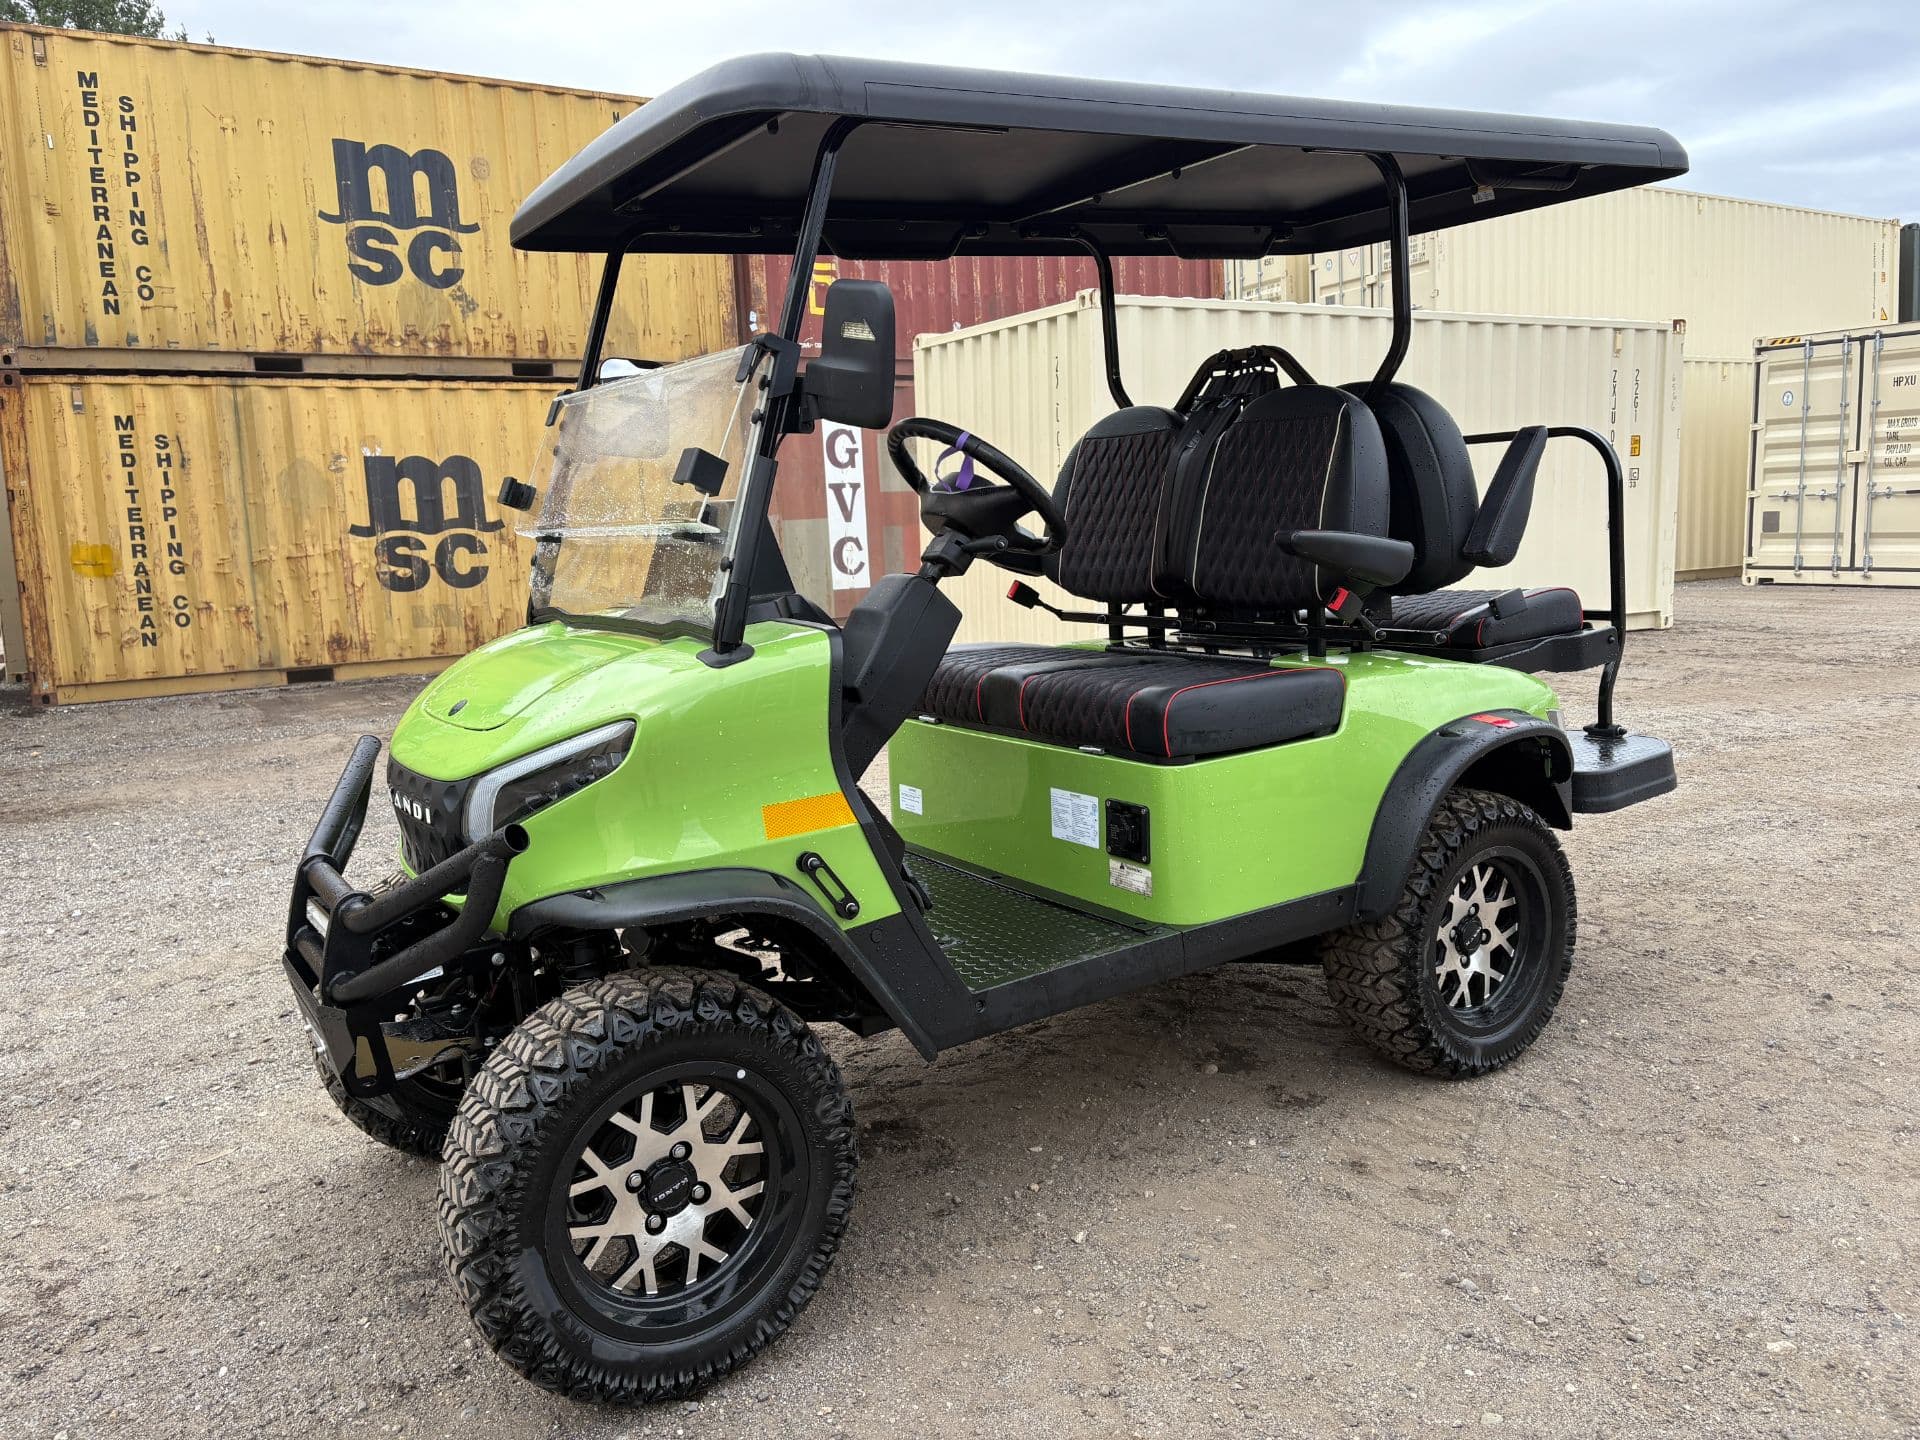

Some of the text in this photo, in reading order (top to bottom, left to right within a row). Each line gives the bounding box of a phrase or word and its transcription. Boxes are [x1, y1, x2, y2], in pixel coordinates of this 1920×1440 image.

[77, 71, 121, 315] MEDITERRANEAN
[118, 95, 155, 301] SHIPPING CO
[1885, 443, 1911, 454] PAYLOAD
[1886, 431, 1899, 441] TARE
[1893, 375, 1917, 387] HPXU
[114, 415, 157, 647] MEDITERRANEAN
[154, 434, 191, 628] SHIPPING CO
[825, 428, 866, 576] GVC
[392, 791, 431, 825] ANDI
